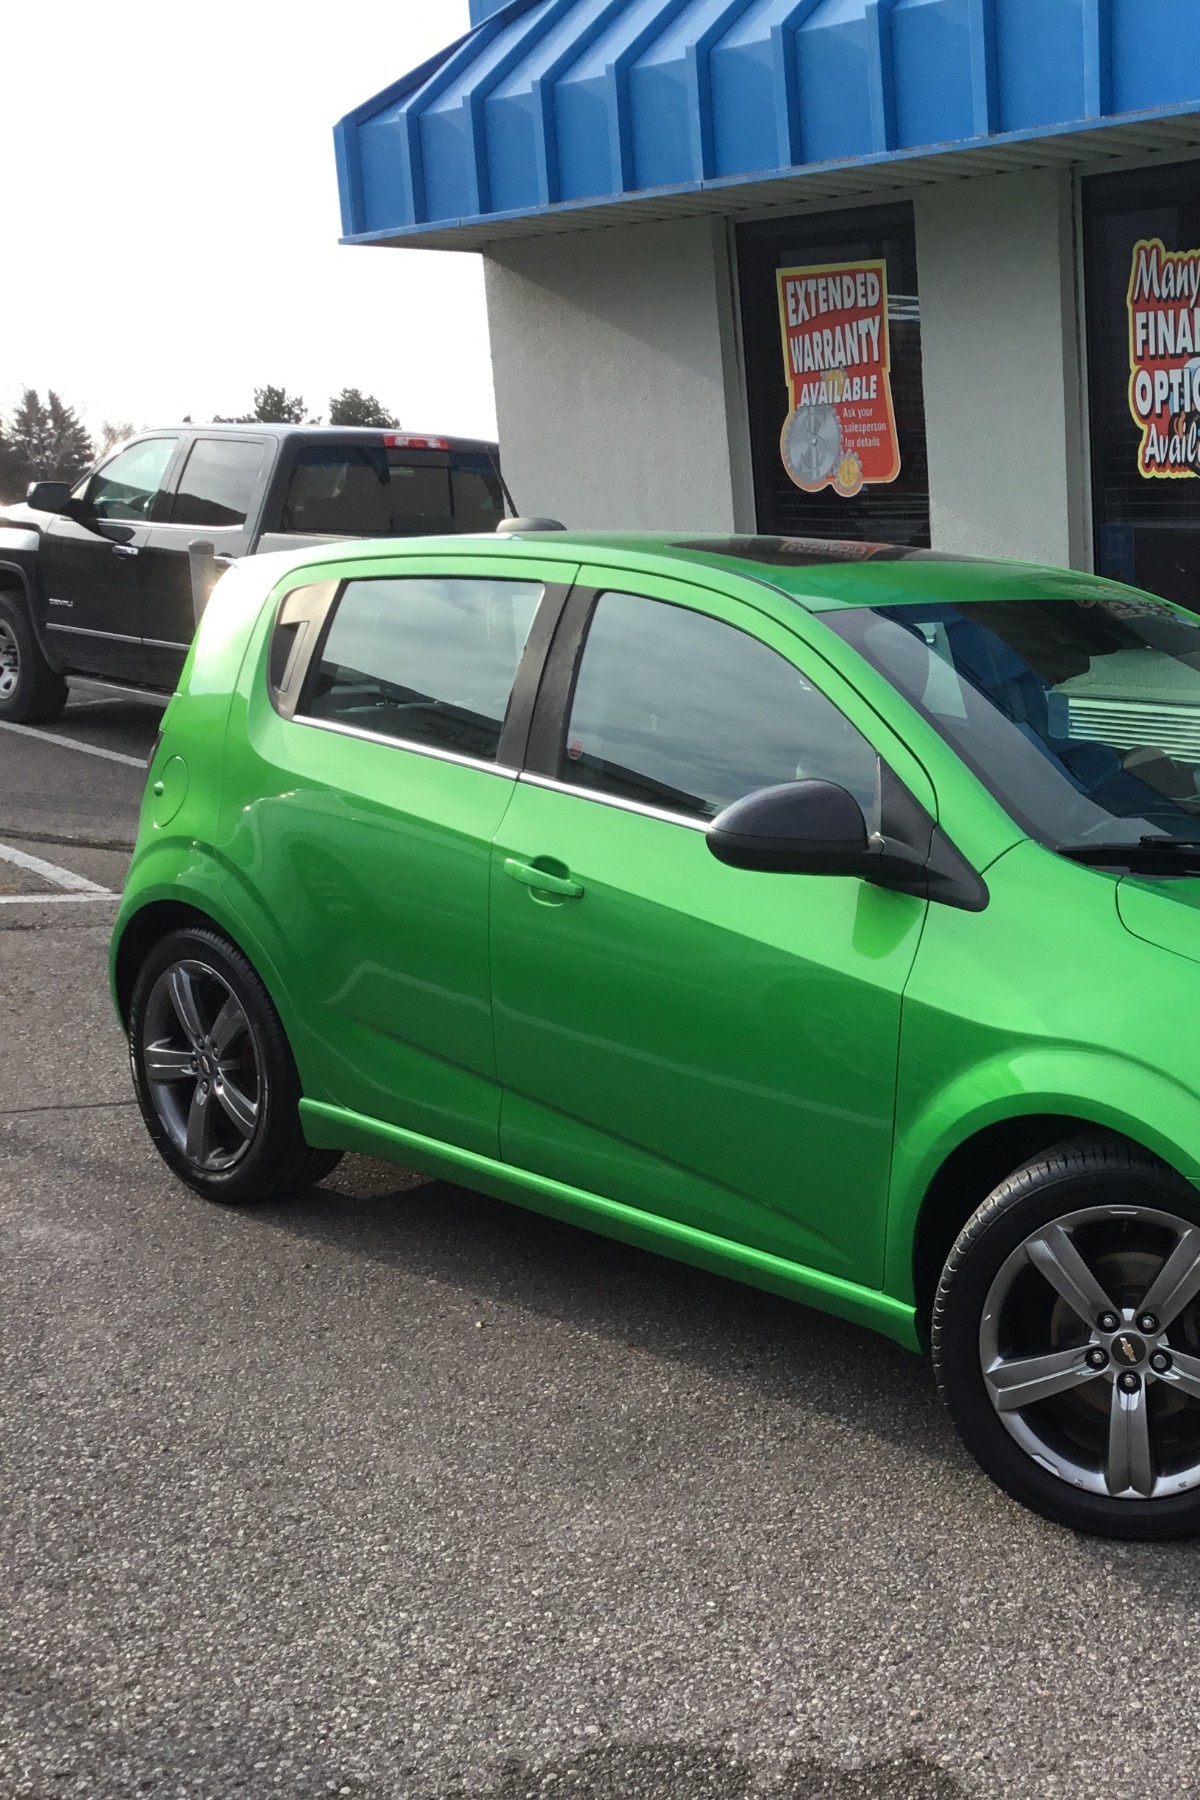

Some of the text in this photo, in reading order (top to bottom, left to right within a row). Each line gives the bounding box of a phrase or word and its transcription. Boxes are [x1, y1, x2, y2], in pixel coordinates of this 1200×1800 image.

[785, 272, 880, 327] EXTENDED
[789, 315, 881, 374] WARRANTY
[800, 375, 877, 408] AVAILABLE
[843, 407, 873, 419] Ask your
[844, 422, 887, 434] salesperson
[845, 436, 881, 448] for details
